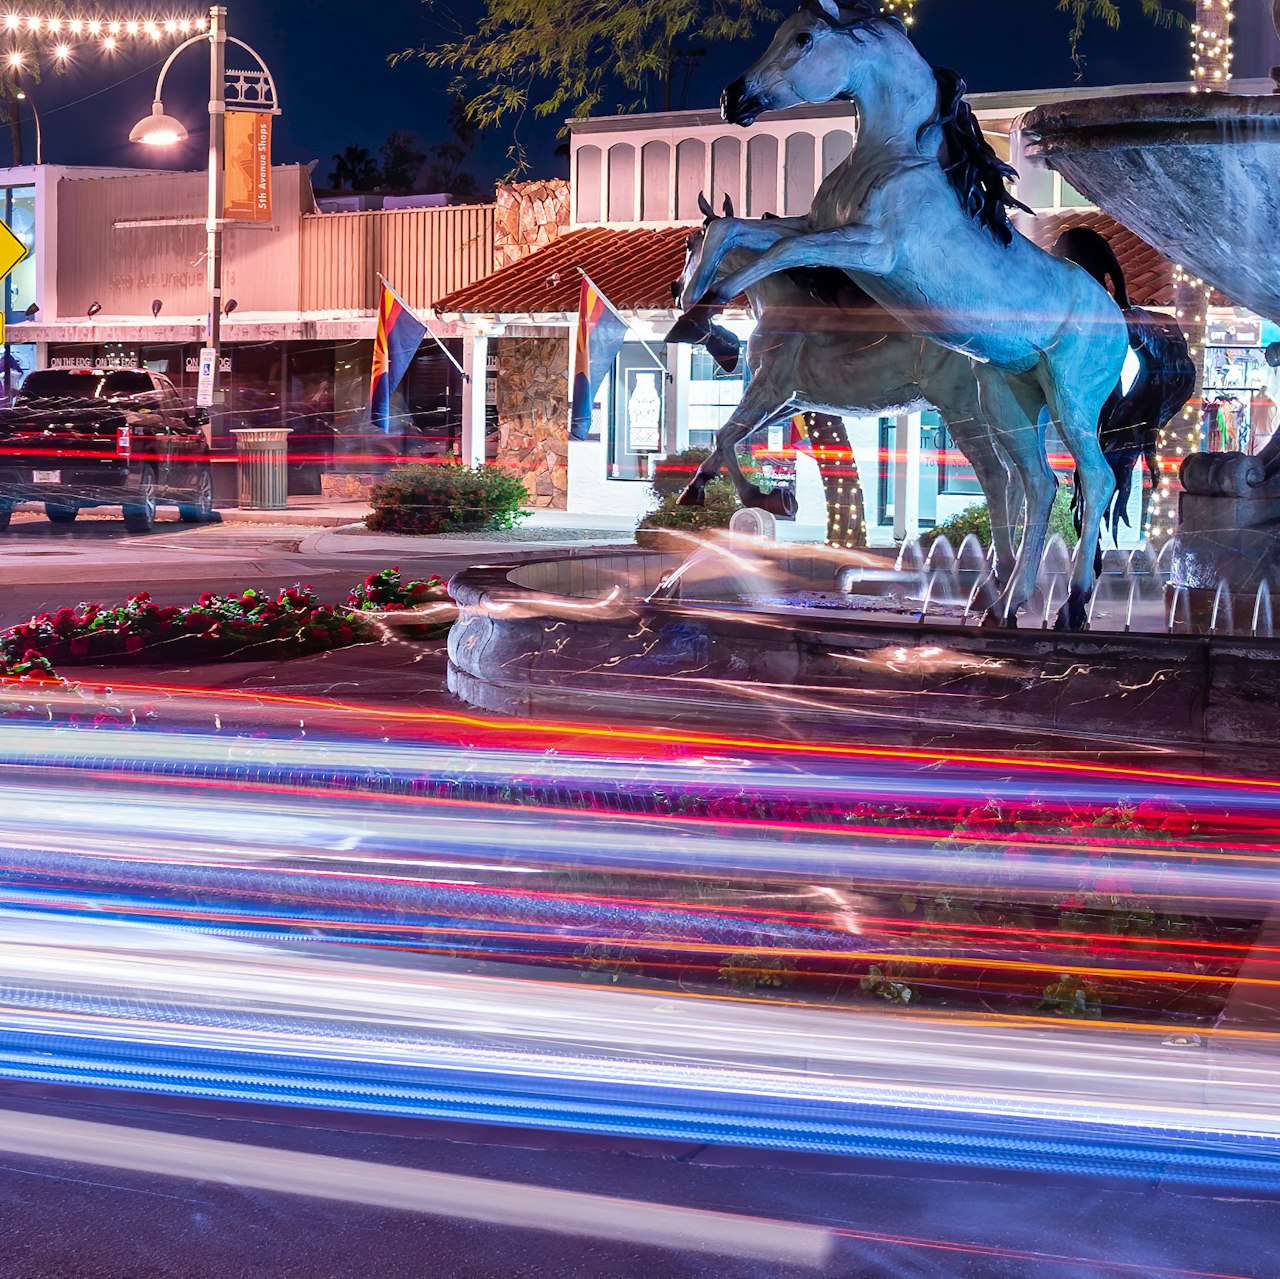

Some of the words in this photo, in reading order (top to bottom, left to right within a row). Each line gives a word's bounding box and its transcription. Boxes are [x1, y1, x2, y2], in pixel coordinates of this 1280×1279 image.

[258, 123, 268, 152] Shops
[258, 154, 267, 189] Avenue
[258, 192, 267, 209] 5th
[51, 357, 62, 367] ON
[63, 357, 75, 367] THE
[95, 357, 107, 367] ON
[186, 358, 199, 367] ON
